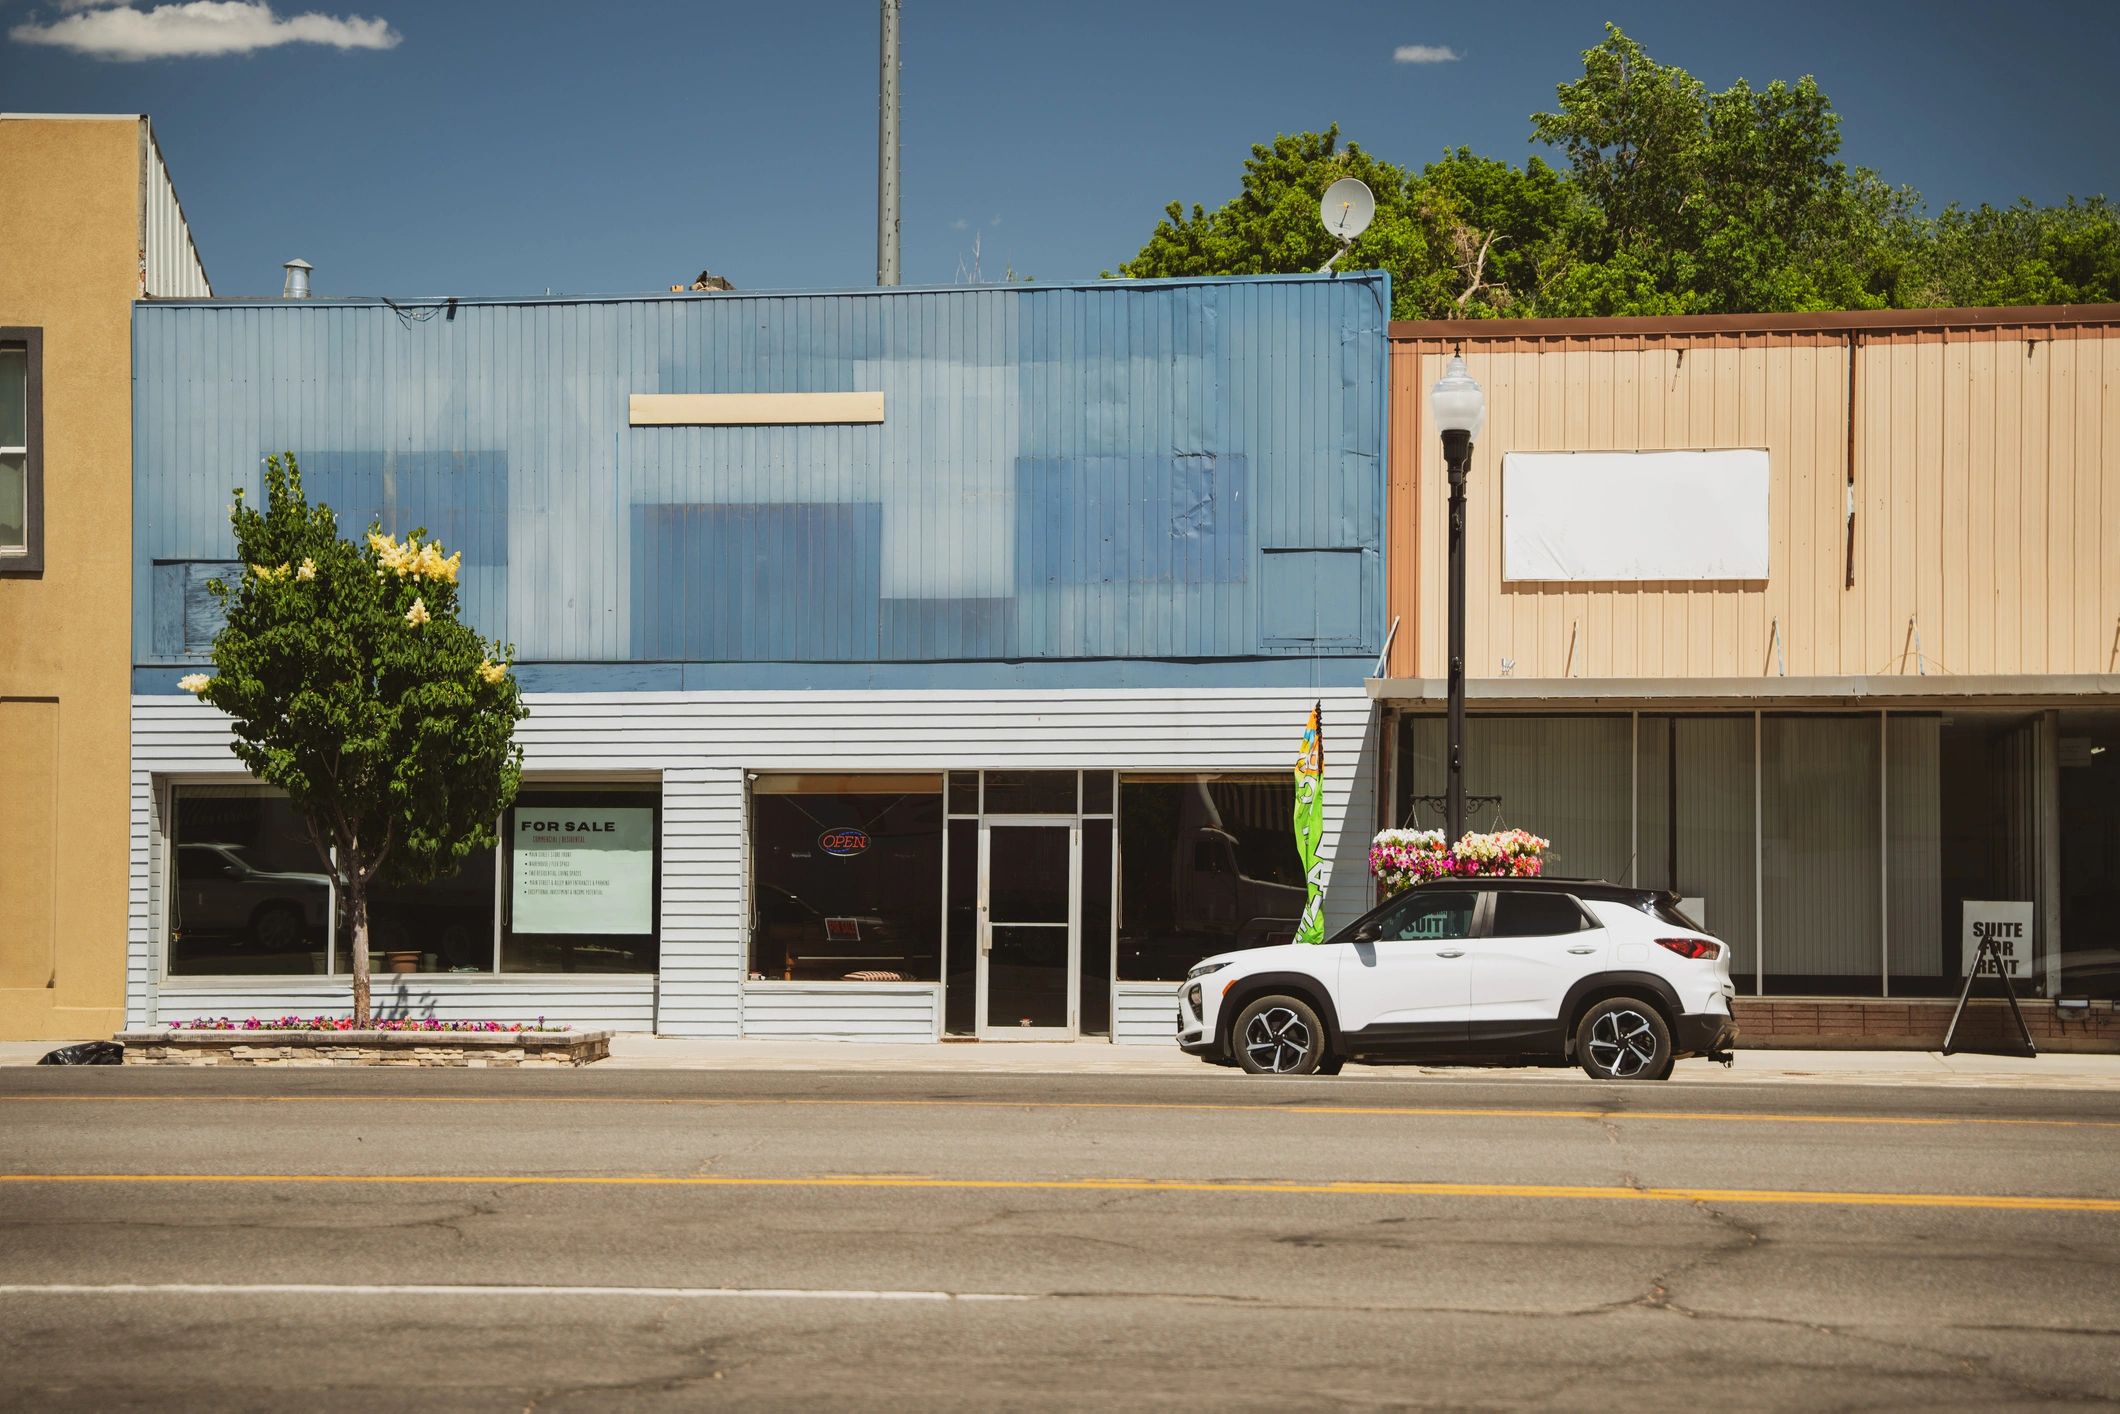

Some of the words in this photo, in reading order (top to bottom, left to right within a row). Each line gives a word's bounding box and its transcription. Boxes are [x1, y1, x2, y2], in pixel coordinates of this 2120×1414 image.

[521, 821, 559, 832] FOR
[565, 821, 615, 832] SALE
[822, 835, 866, 848] OPEN
[1973, 922, 2022, 937] SUITE
